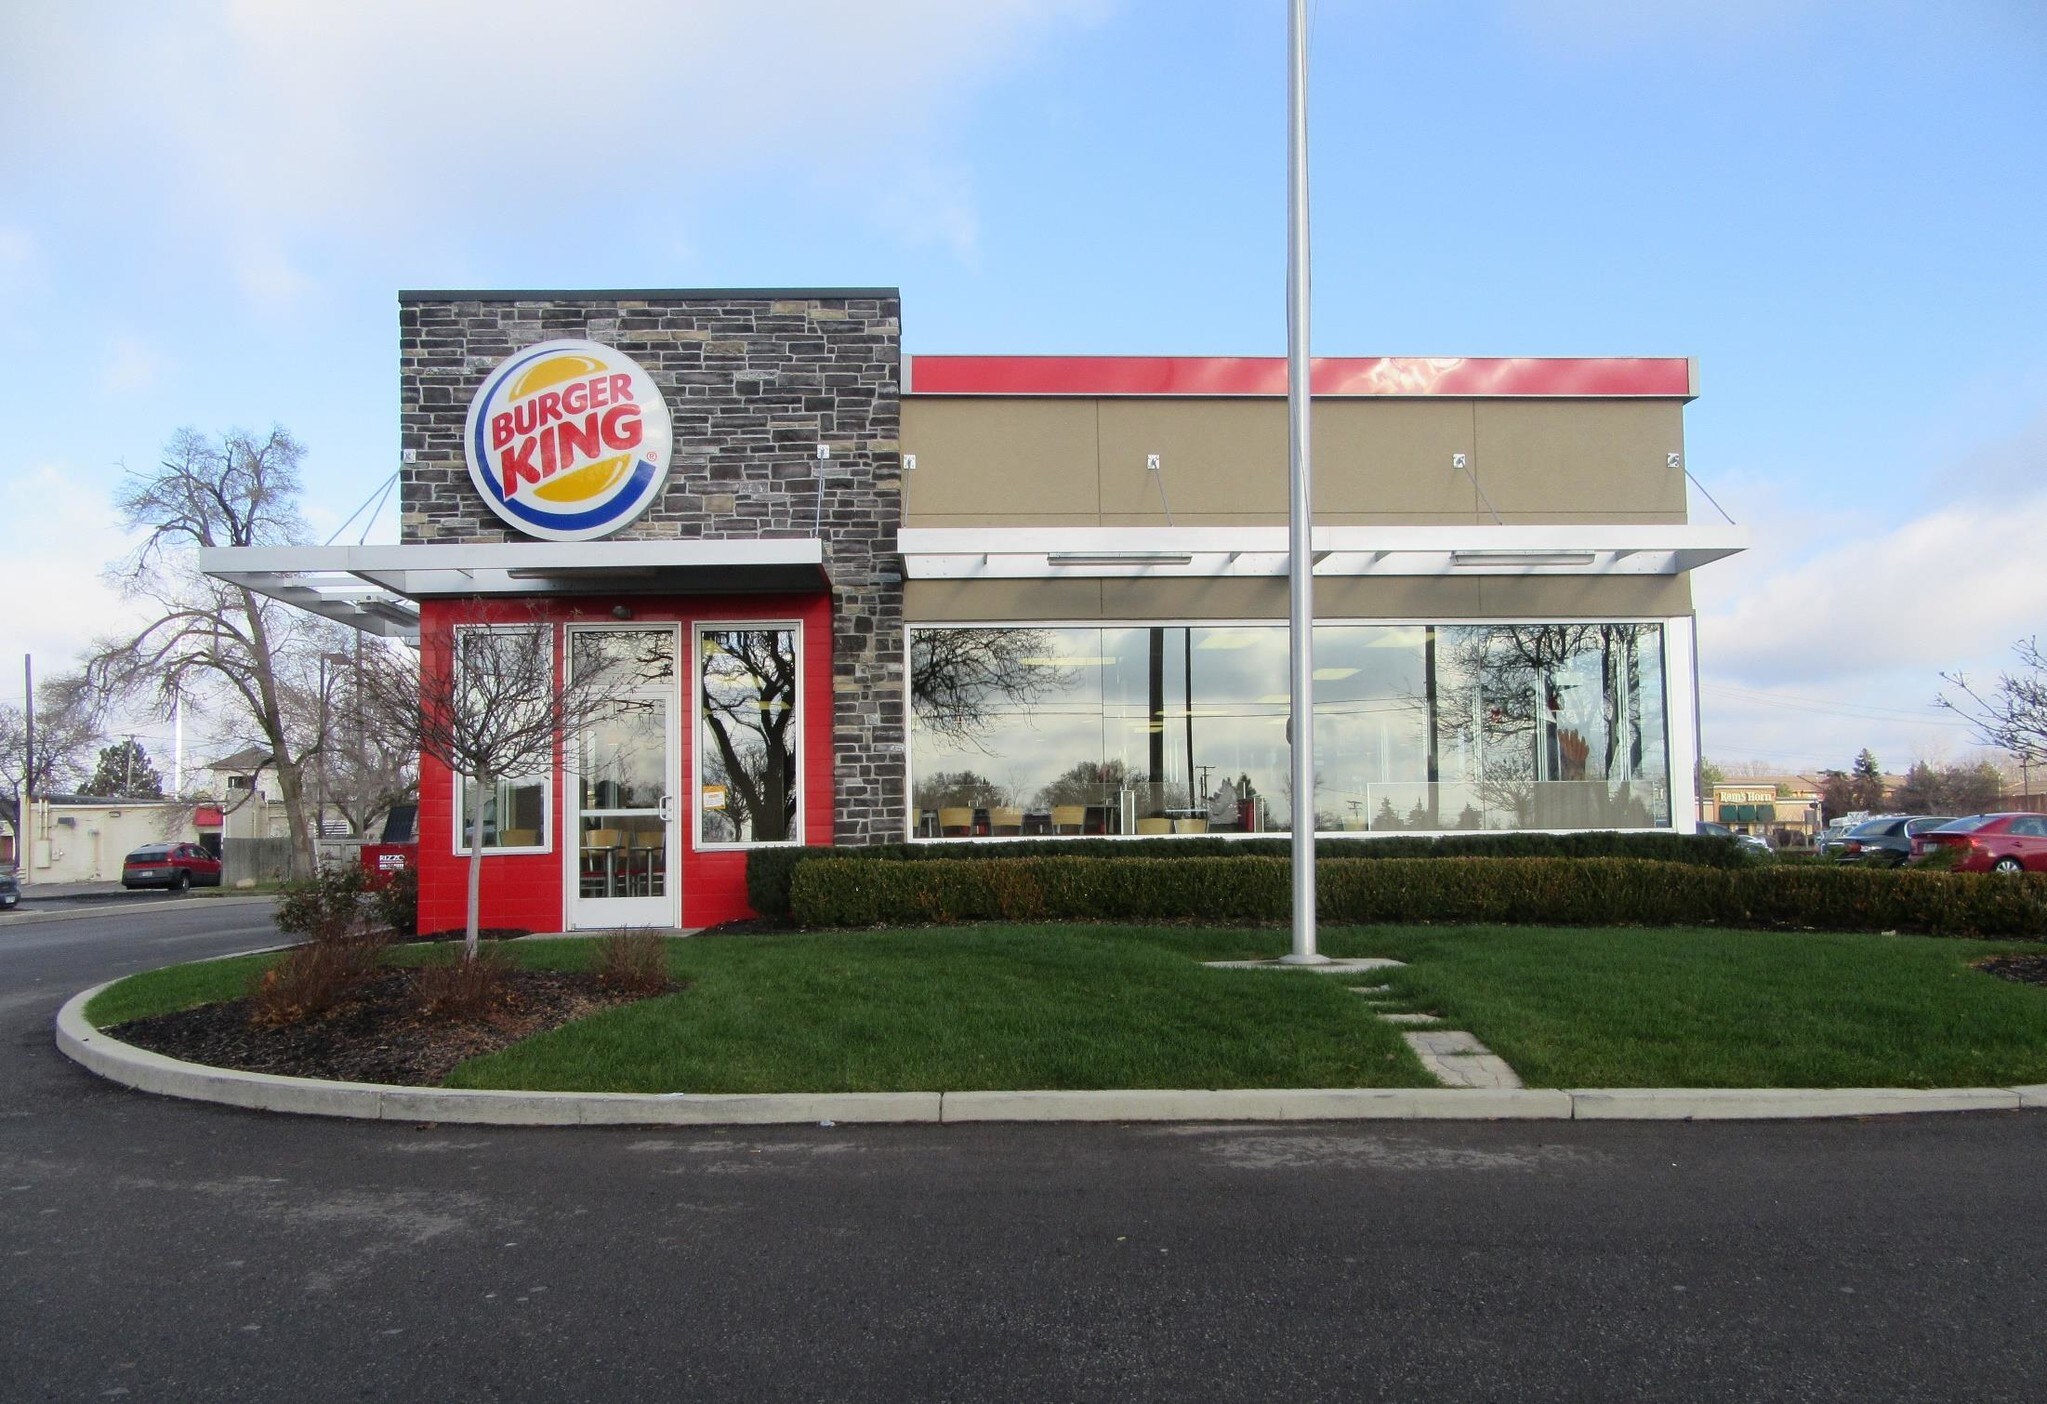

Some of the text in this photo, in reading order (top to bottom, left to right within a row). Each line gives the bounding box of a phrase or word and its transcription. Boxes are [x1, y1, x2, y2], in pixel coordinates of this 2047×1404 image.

[492, 373, 634, 451] BURGER
[500, 403, 642, 499] KING
[1720, 791, 1772, 802] Ram's Horn
